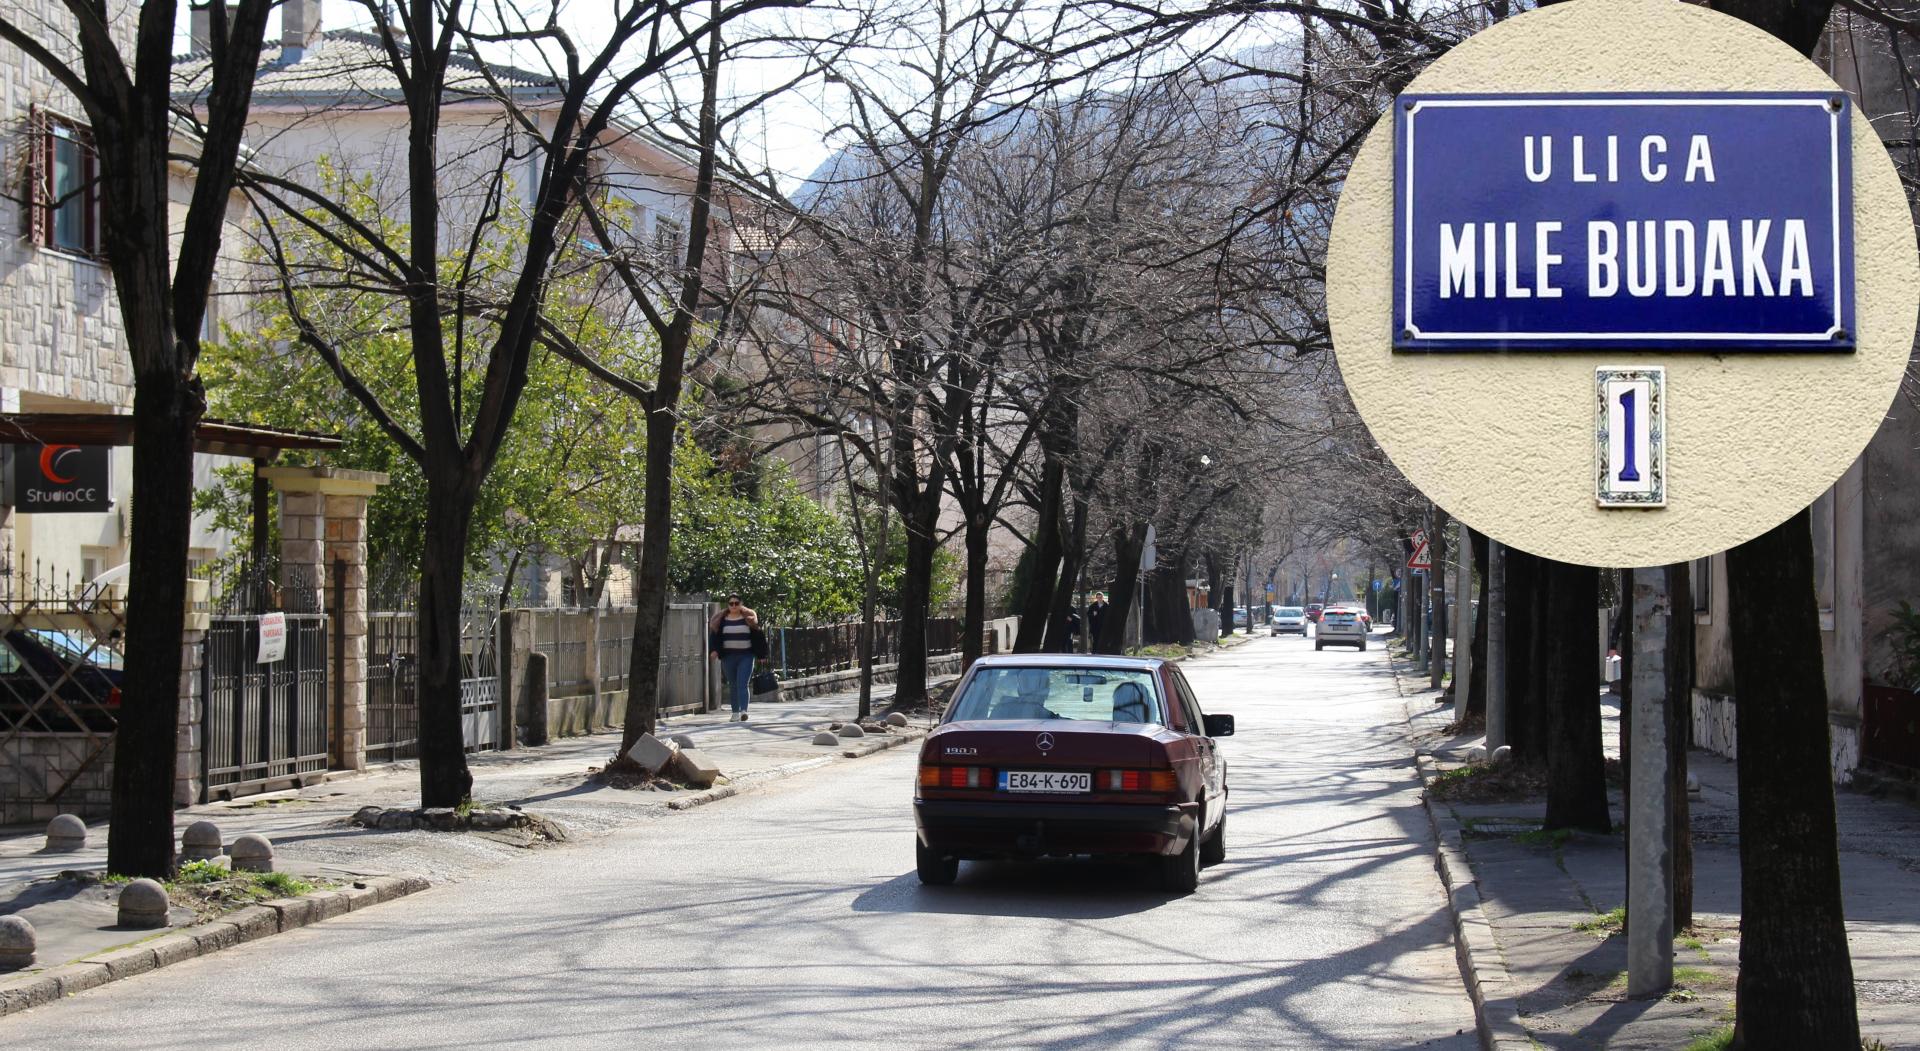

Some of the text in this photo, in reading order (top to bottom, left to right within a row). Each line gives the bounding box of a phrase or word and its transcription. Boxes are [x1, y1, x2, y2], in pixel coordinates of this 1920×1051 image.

[1525, 134, 1716, 182] ULICA
[1440, 219, 1815, 298] MILE BUDAKA
[1618, 388, 1641, 482] 1
[1009, 773, 1088, 790] E84-K-690
